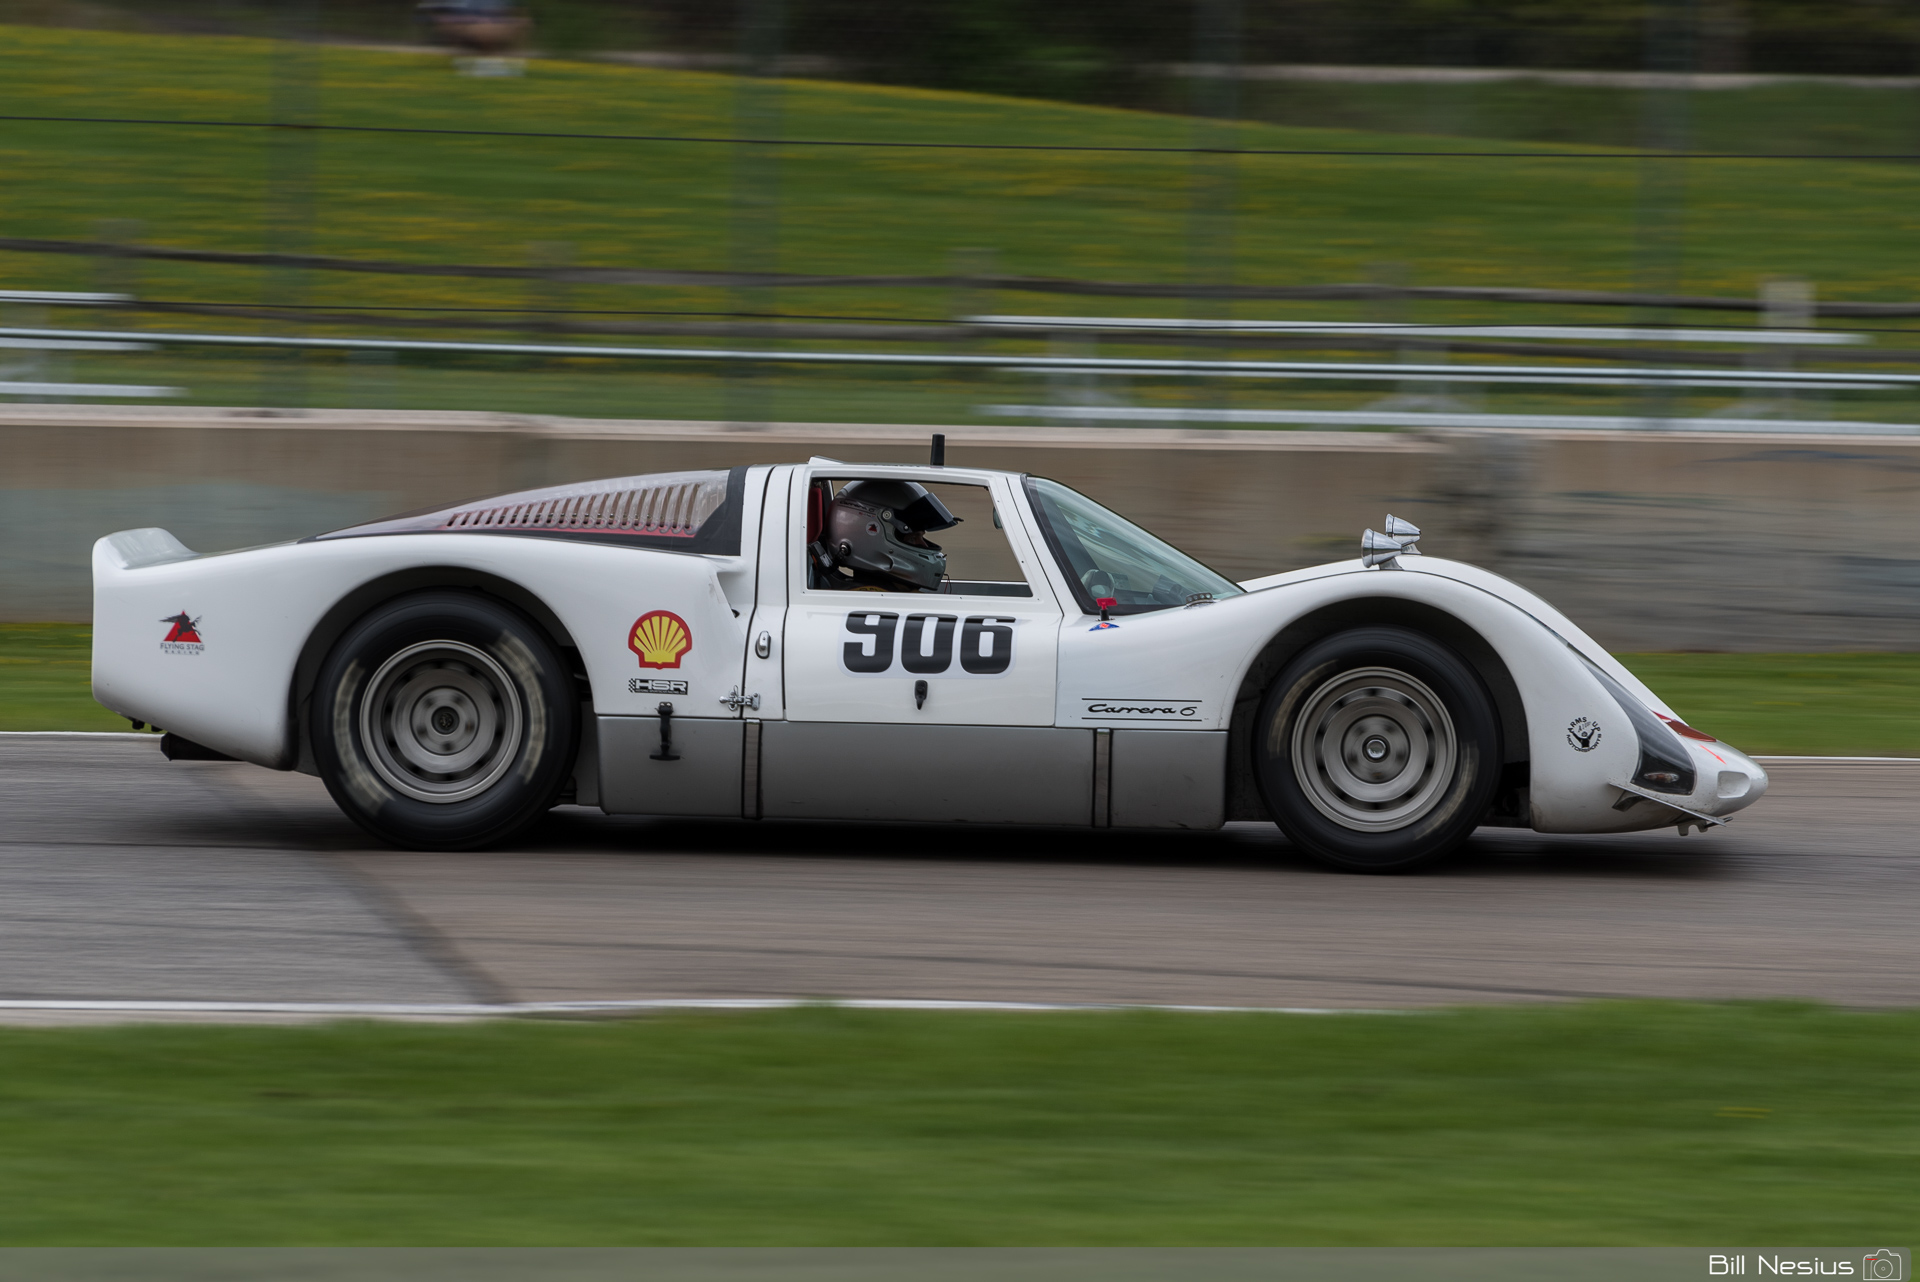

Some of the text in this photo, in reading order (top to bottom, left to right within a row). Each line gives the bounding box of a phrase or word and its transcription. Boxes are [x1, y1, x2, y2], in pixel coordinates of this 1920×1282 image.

[186, 643, 205, 651] STAG
[843, 611, 1016, 675] 906
[635, 679, 687, 692] HSR
[1088, 703, 1197, 716] Carrera 6
[1568, 716, 1587, 732] ARMS
[1591, 720, 1601, 732] UP
